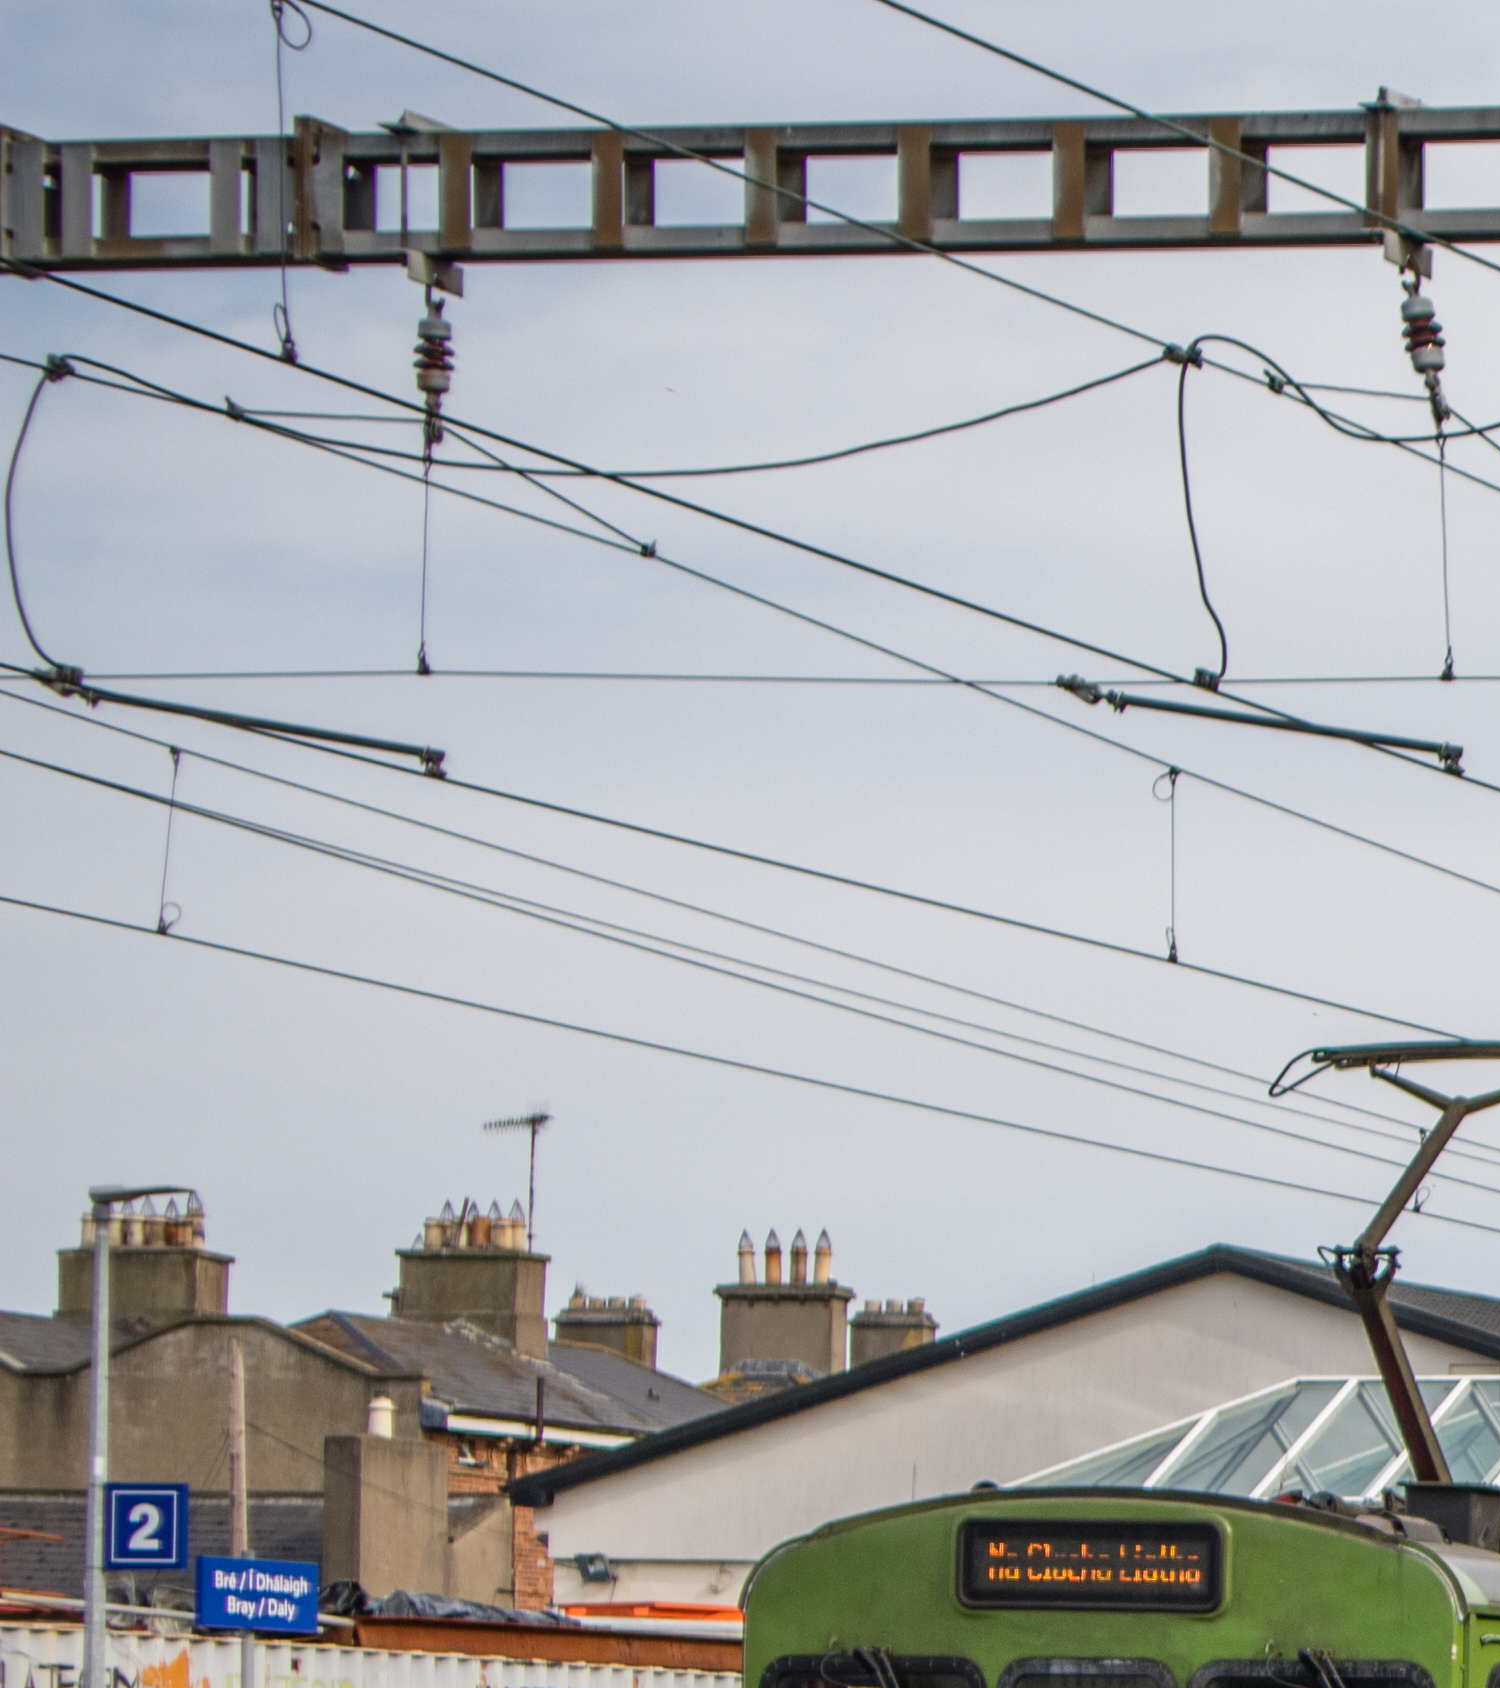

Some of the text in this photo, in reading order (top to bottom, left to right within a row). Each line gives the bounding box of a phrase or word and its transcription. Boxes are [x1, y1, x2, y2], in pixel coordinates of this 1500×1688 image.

[127, 1502, 161, 1551] 2
[227, 1595, 256, 1620] Bray
[267, 1598, 296, 1622] Daly
